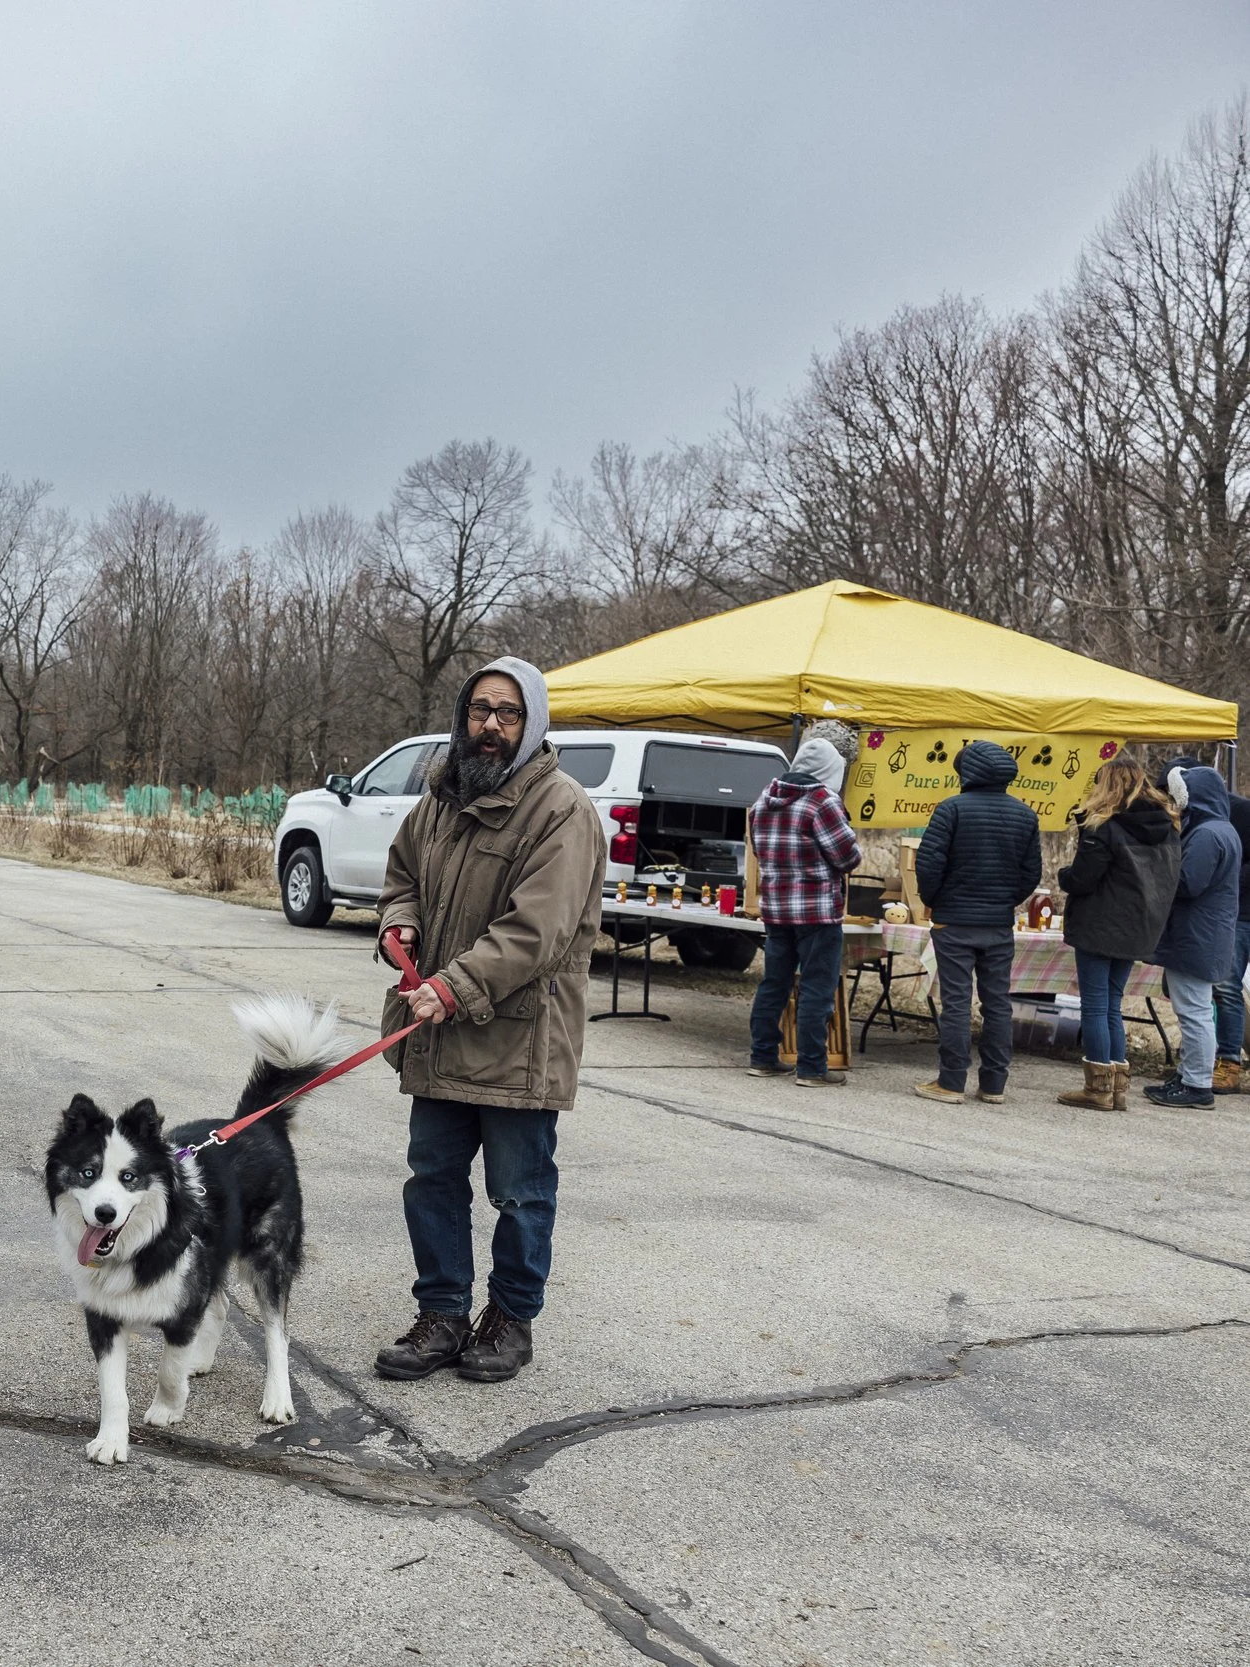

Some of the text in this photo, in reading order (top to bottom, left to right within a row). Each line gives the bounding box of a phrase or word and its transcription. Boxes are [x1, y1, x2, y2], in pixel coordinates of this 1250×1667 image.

[904, 774, 940, 789] Pure
[1011, 775, 1058, 795] Honey
[893, 799, 938, 817] Krueg
